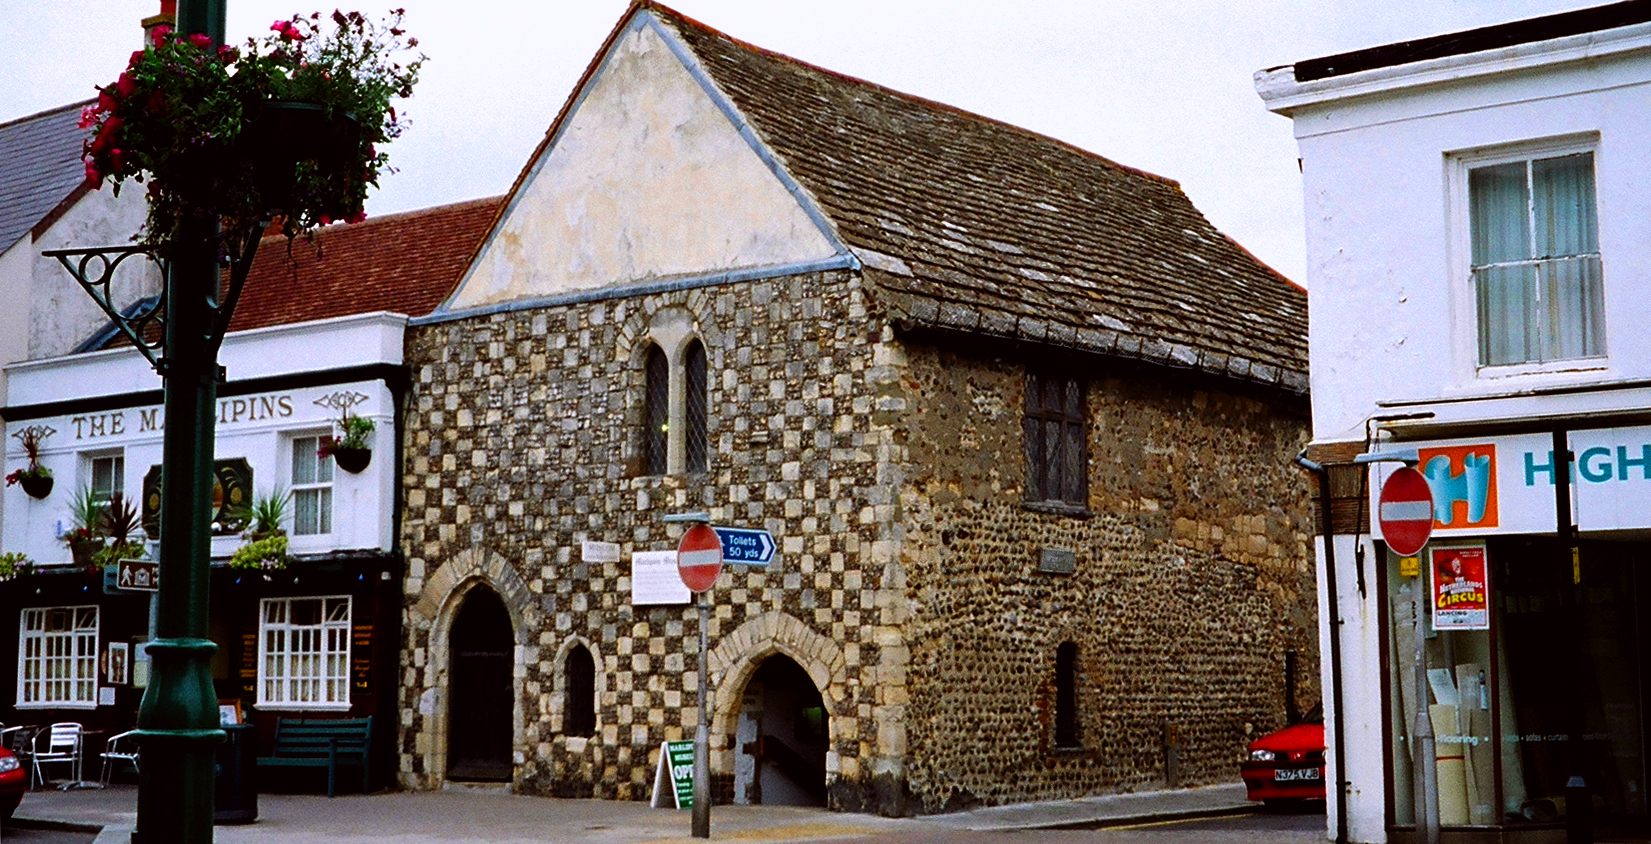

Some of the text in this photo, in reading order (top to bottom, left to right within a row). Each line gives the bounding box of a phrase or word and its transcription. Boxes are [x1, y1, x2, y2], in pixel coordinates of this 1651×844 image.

[71, 395, 293, 440] THE MIPINS
[1524, 444, 1651, 486] HGH
[729, 534, 757, 546] Toilets
[729, 546, 759, 559] 50 yds
[1437, 591, 1484, 608] CIRCUS
[1438, 732, 1479, 747] flooring
[674, 764, 693, 779] OPE
[1276, 769, 1299, 780] N375
